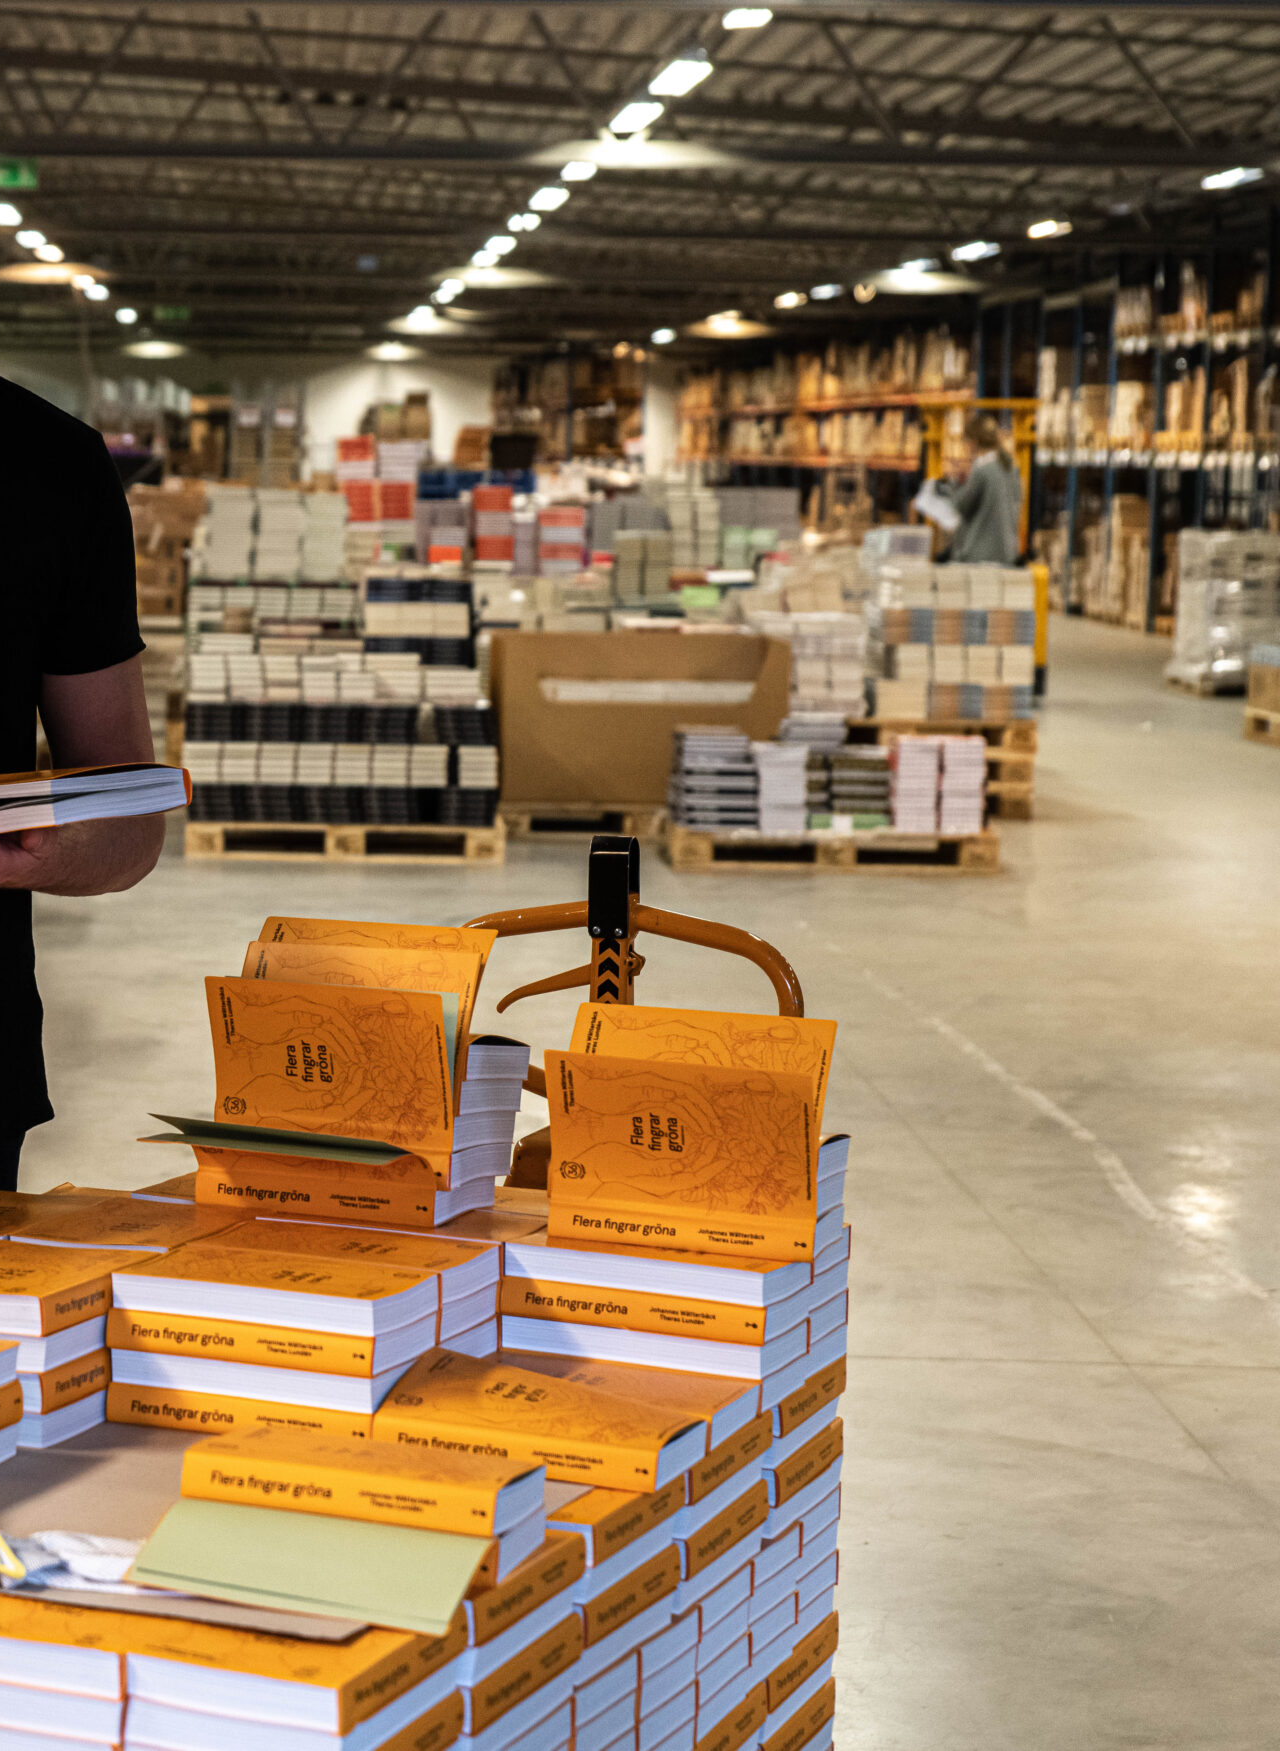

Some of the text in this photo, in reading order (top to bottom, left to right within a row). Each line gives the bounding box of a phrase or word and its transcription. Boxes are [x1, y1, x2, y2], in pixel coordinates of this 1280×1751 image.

[285, 1045, 298, 1077] Flera
[301, 1040, 316, 1082] fingrar
[316, 1045, 333, 1083] gröna
[629, 1116, 644, 1146] Flera
[648, 1112, 665, 1151] fingrar
[665, 1117, 683, 1152] gröna
[218, 1183, 310, 1202] Flera fingrar gröna
[573, 1215, 676, 1236] Flera fingrar gröna
[525, 1292, 627, 1314] Flera fingrar gröna
[131, 1324, 234, 1347] Flera fingrar gröna
[131, 1400, 233, 1423] Flera fingrar gröna
[398, 1432, 428, 1447] Flera
[211, 1470, 331, 1498] Flera fingrar gröna
